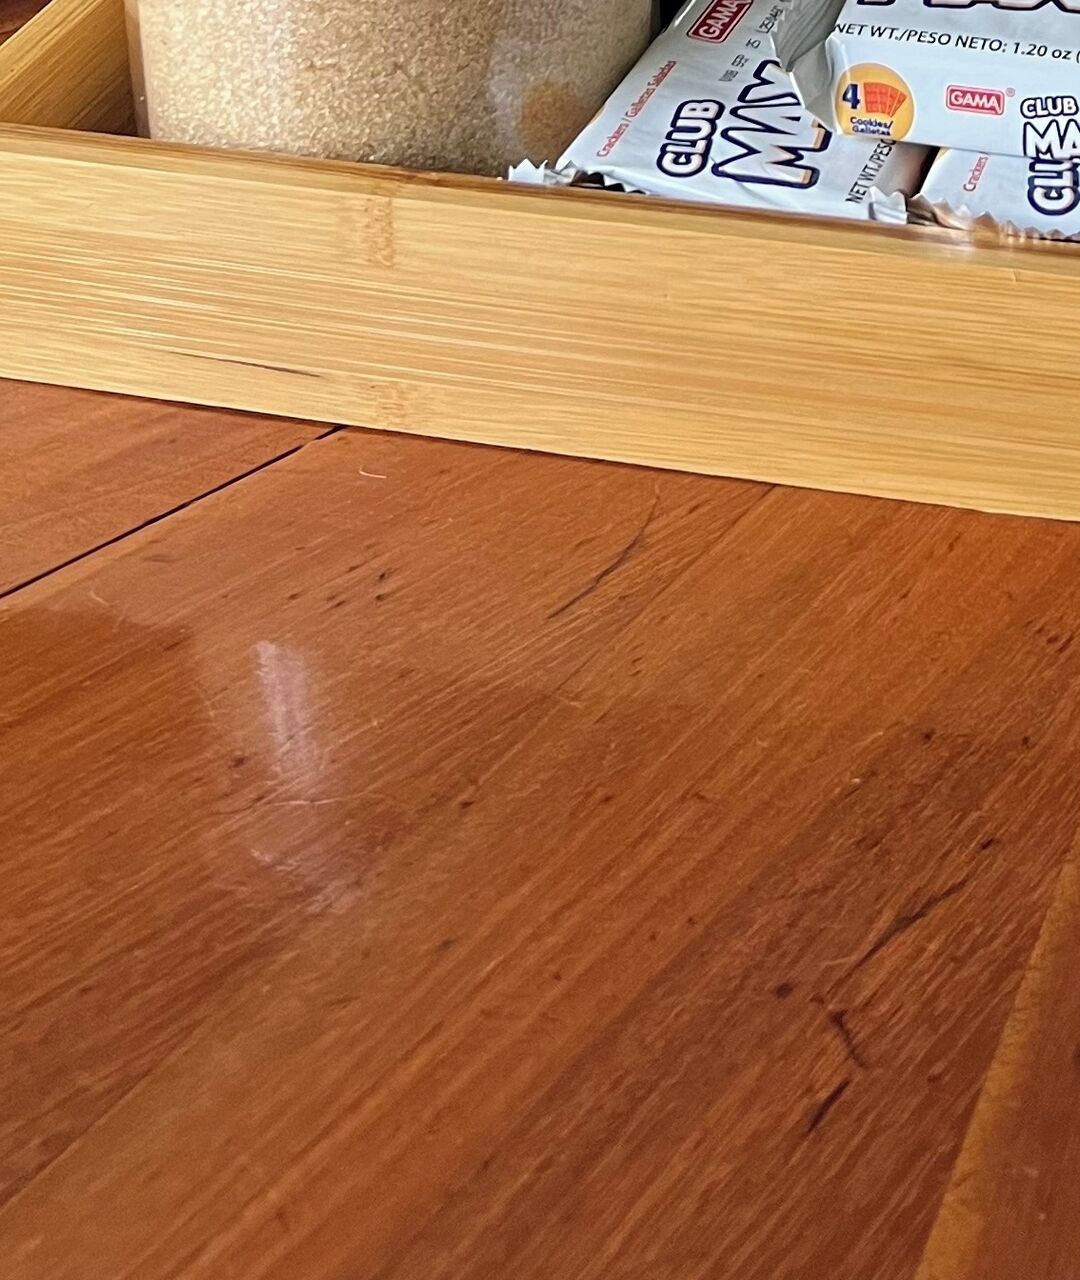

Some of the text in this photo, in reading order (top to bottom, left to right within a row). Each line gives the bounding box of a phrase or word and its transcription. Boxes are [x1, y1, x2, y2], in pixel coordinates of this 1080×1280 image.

[832, 23, 868, 36] NET
[871, 27, 952, 47] WT./PESO
[955, 35, 1008, 53] NETO:
[1014, 42, 1048, 58] 1.20
[1052, 48, 1072, 60] oz
[842, 83, 861, 110] 4
[949, 90, 1001, 115] GAMA
[1020, 95, 1079, 119] CLUB
[656, 99, 726, 178] CLUB
[845, 180, 869, 204] NET
[1028, 157, 1080, 216] CLU
